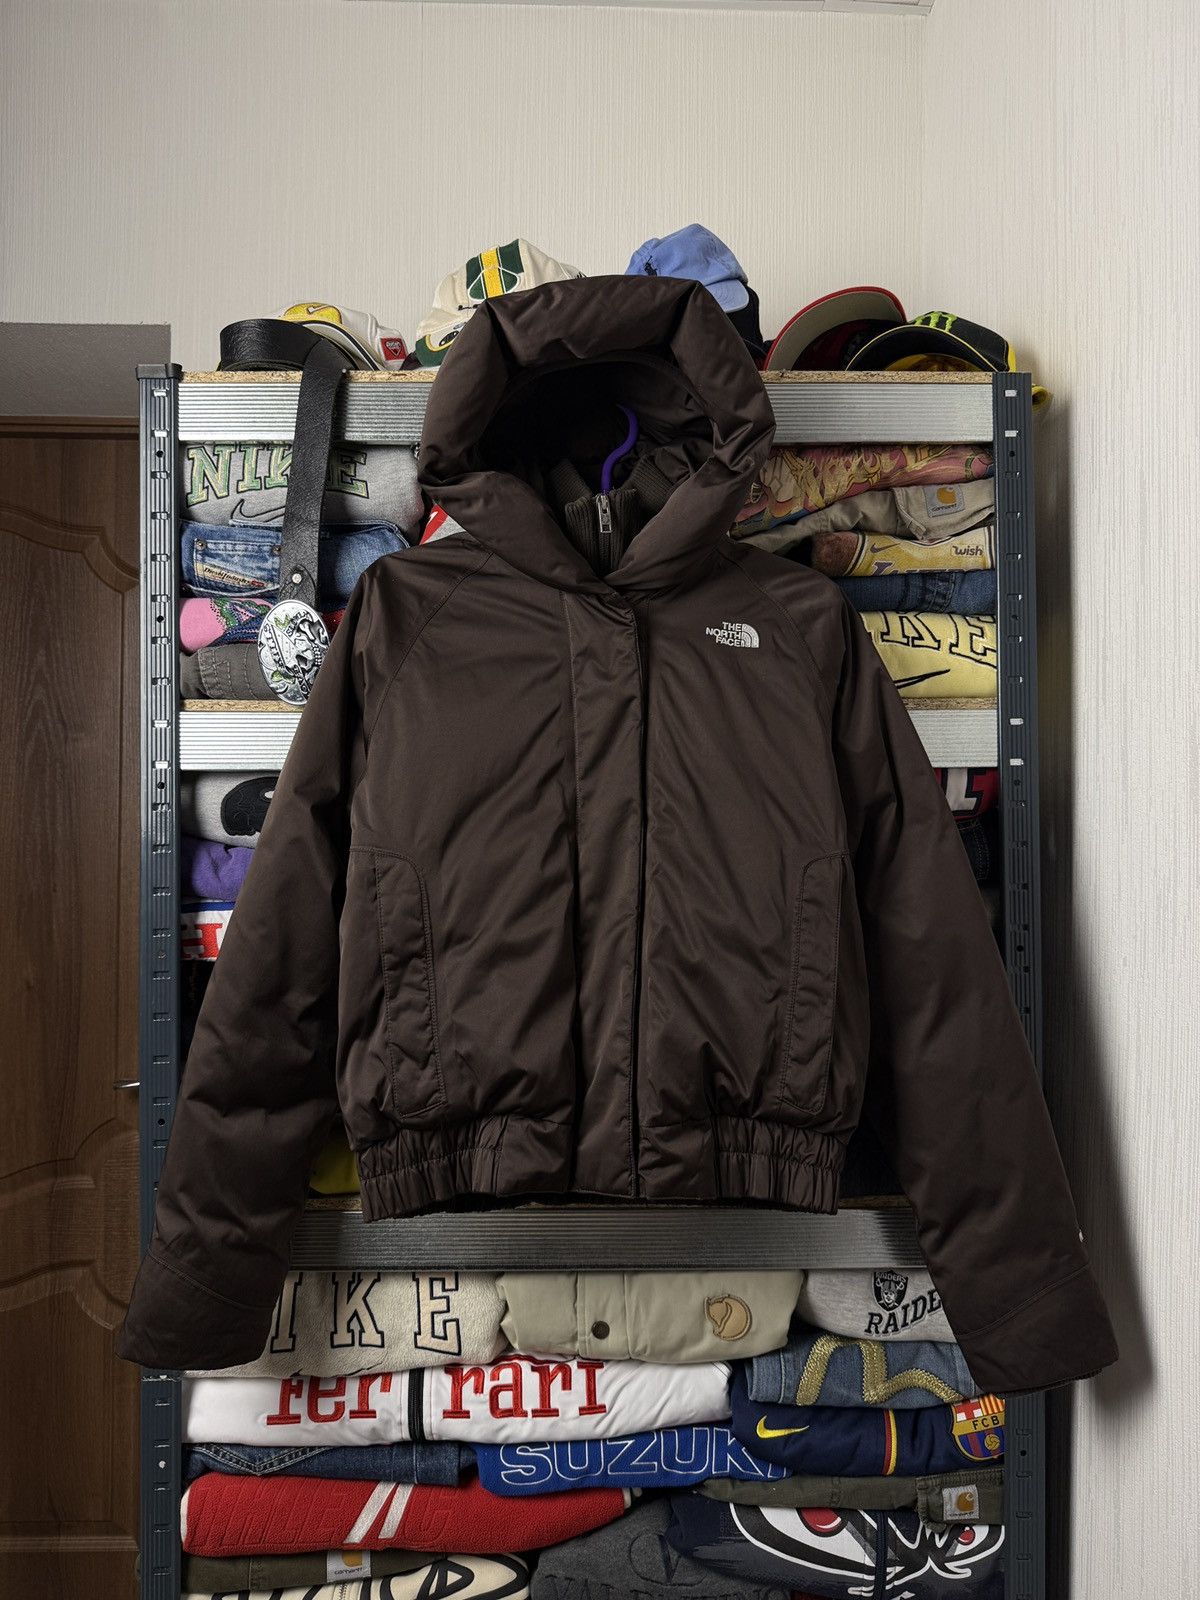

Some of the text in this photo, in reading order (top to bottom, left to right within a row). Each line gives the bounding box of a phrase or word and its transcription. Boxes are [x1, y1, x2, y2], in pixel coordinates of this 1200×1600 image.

[952, 545, 984, 556] wish
[705, 626, 741, 640] NORTH
[722, 621, 742, 632] THE
[715, 635, 741, 648] FACE
[270, 1271, 462, 1356] IKE
[864, 1289, 942, 1335] RAIDE
[972, 1415, 1000, 1430] FCB
[500, 1427, 788, 1486] SUZUK
